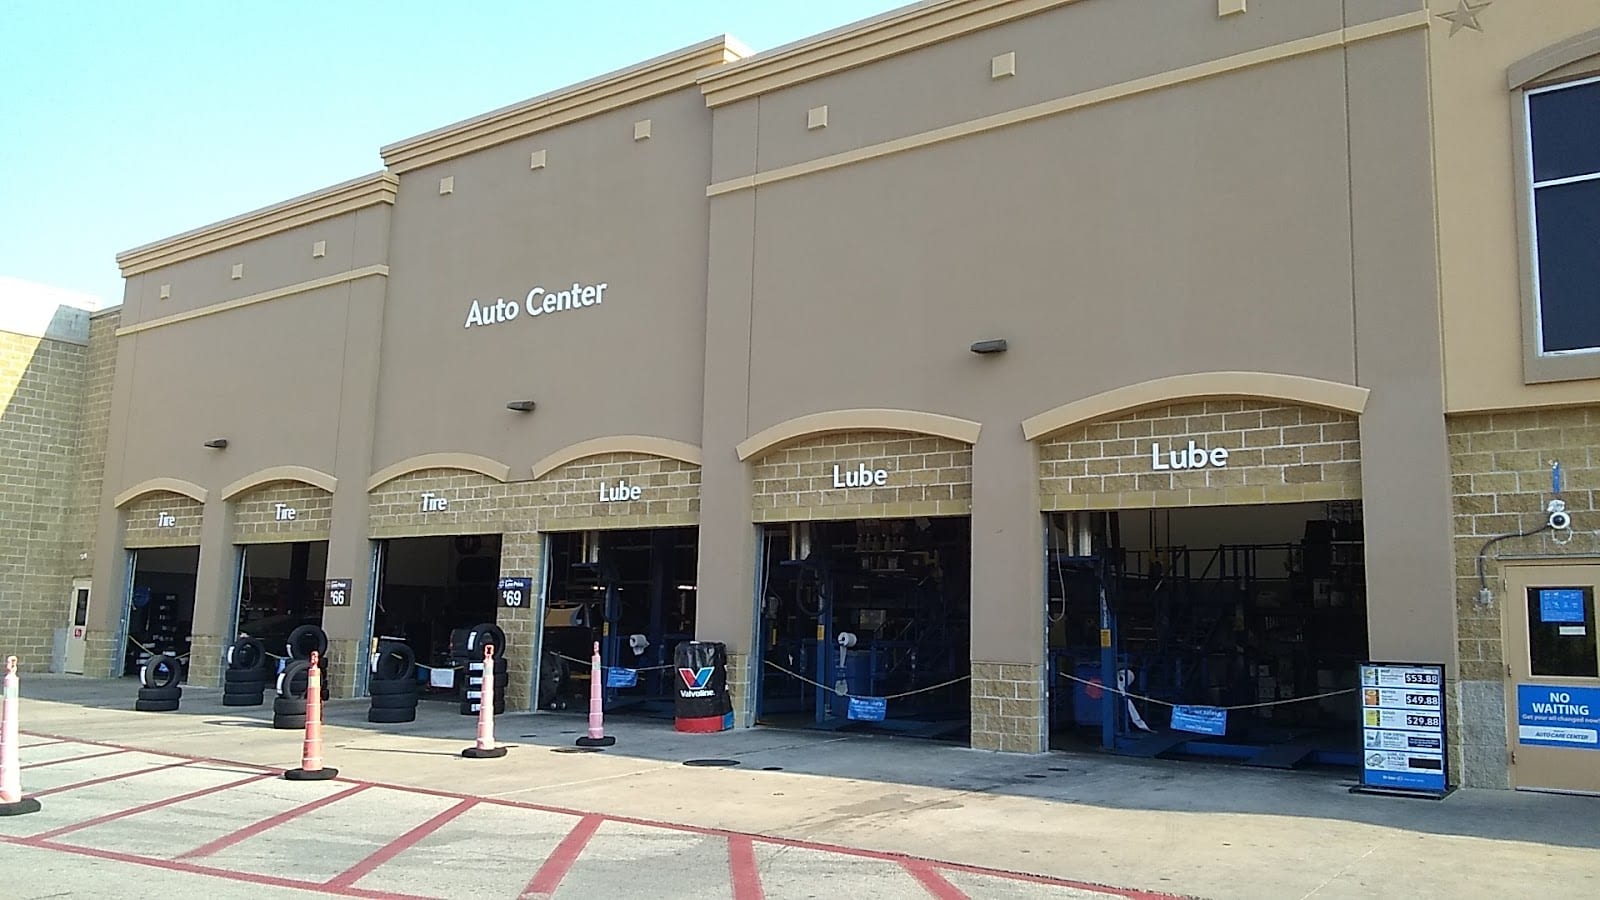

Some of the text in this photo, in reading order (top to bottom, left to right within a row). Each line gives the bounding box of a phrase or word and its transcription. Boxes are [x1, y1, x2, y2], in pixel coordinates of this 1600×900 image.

[464, 283, 607, 328] Auto Center
[1152, 440, 1229, 470] Lube
[833, 464, 888, 488] Lube
[599, 480, 642, 502] Lube
[421, 493, 448, 511] Tire
[158, 511, 176, 527] Tire
[274, 503, 296, 520] Tire
[502, 590, 522, 606] $69
[1405, 674, 1438, 683] $53.88
[1406, 695, 1438, 705] $49.88
[1549, 692, 1570, 704] NO
[1532, 702, 1589, 716] WAITING
[1407, 716, 1440, 726] $29.88
